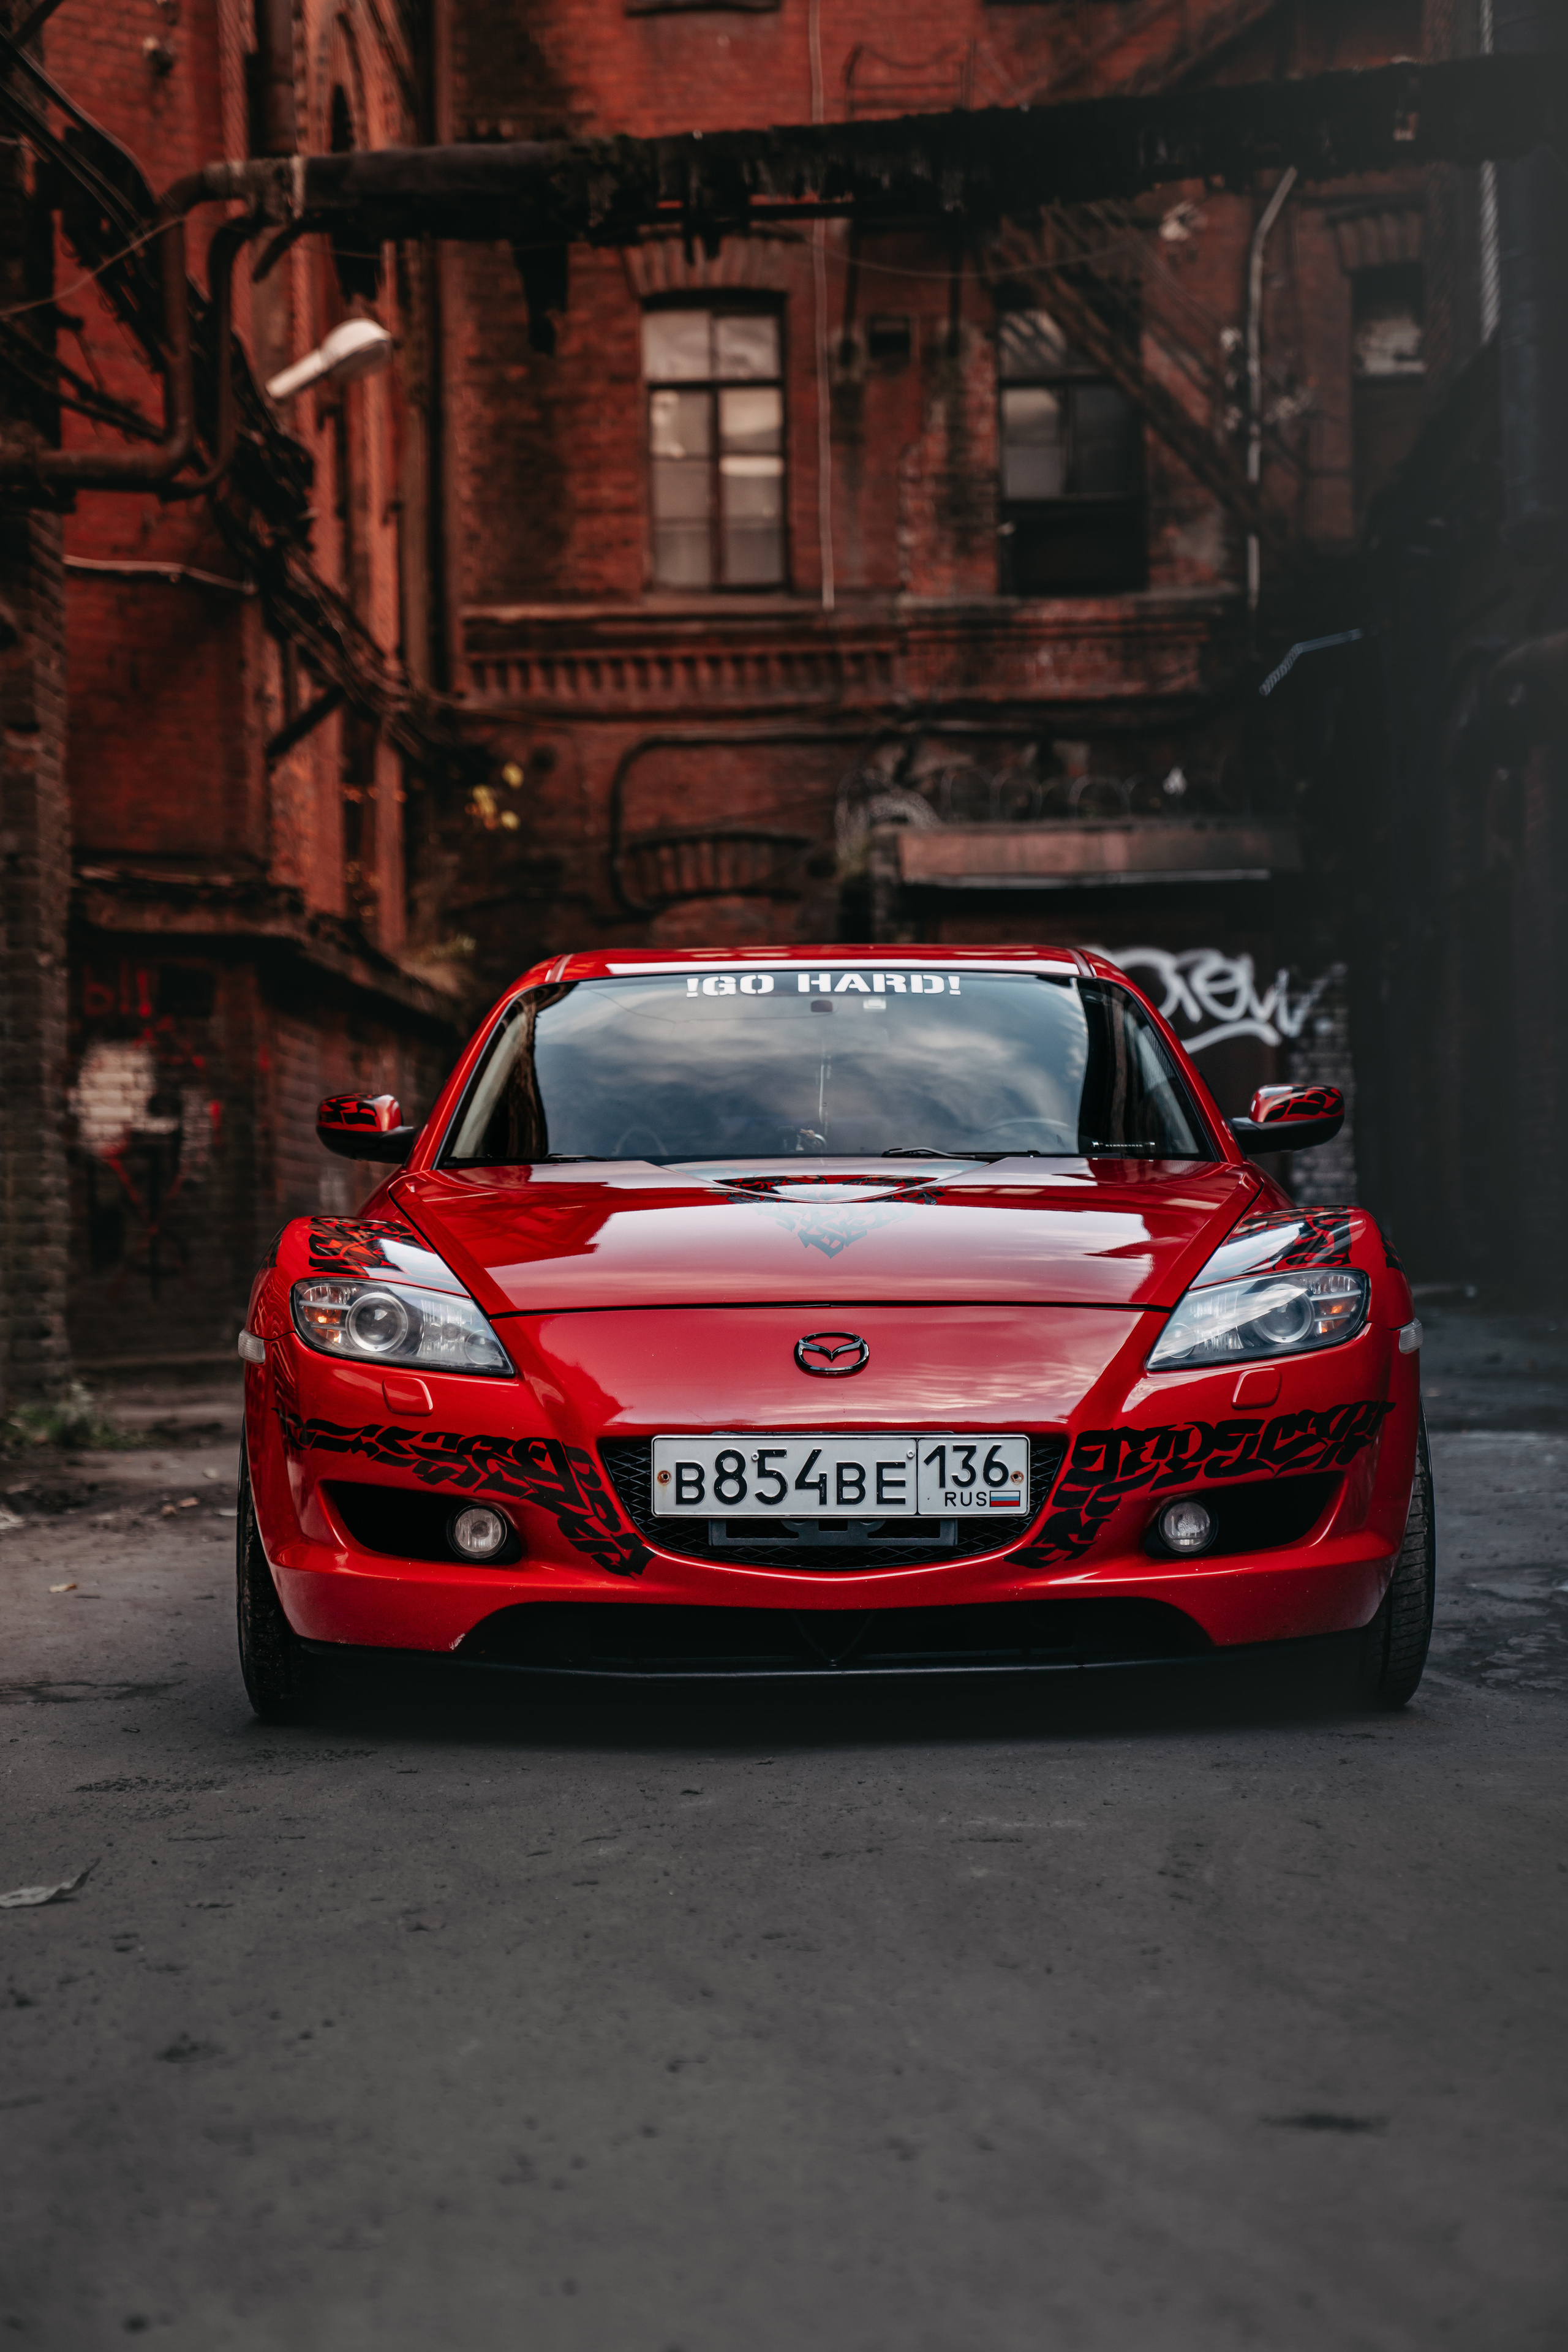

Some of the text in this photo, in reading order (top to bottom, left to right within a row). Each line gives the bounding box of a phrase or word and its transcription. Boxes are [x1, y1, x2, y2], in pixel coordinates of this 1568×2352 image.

[686, 973, 961, 998] !GO HARD!
[923, 1444, 1009, 1488] 136
[944, 1491, 987, 1507] RUS
